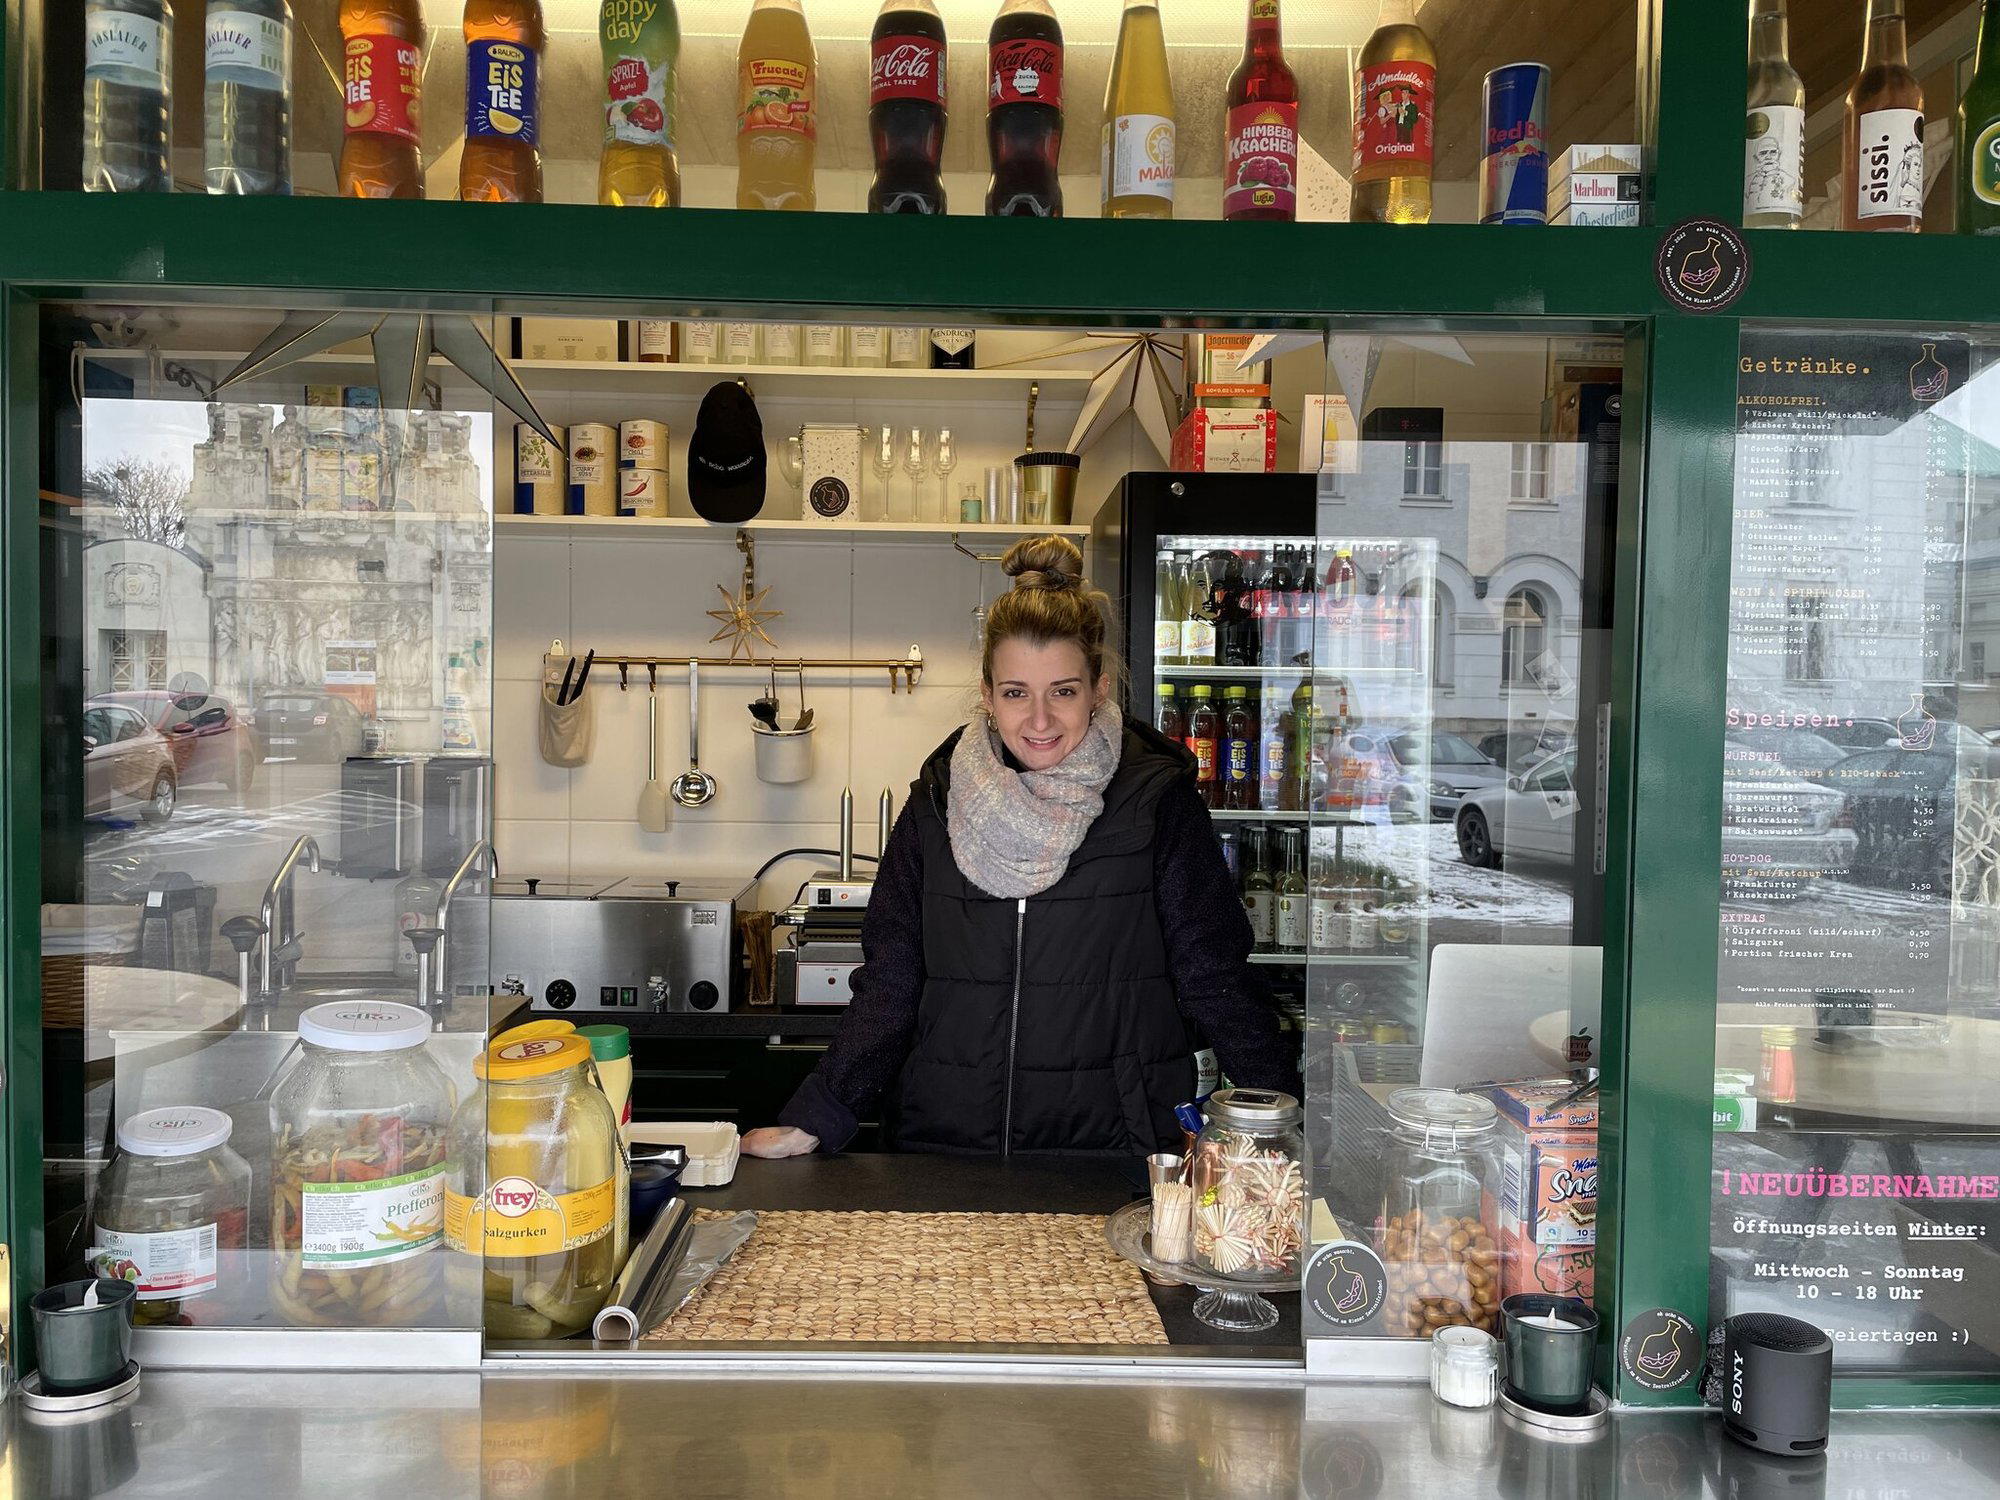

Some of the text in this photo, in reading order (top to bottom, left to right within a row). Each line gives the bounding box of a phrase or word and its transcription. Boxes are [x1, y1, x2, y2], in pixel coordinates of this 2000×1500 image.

[607, 18, 643, 44] day
[497, 48, 521, 59] RAUCH
[611, 63, 641, 84] SPRIZZ
[893, 79, 918, 87] TASTE
[1367, 70, 1424, 91] Almdudler
[619, 82, 637, 91] Apfel
[345, 80, 372, 105] TEE
[487, 84, 523, 111] TEE
[1242, 125, 1293, 141] HIMBEER
[1487, 120, 1522, 145] Red
[1375, 142, 1415, 154] Original
[1861, 134, 1890, 204] sissi.
[1574, 179, 1616, 198] Marlboro
[1575, 204, 1637, 226] Chesterfield
[1739, 356, 1871, 375] Getränke.
[1737, 396, 1827, 406] ALKOHOLFREI.
[1751, 409, 1792, 419] Vöslauer
[1751, 422, 1832, 430] Himbeer Kracherl
[1927, 425, 1947, 433] 2,50
[1751, 433, 1796, 441] Apfelsaft
[1750, 445, 1819, 453] Coca-Cola/Zero
[1750, 456, 1781, 464] Eistee
[1804, 468, 1840, 476] Frucade
[1925, 470, 1946, 478] 2,80
[1749, 478, 1779, 486] MAKAVA
[1734, 509, 1770, 519] BIER.
[1748, 533, 1803, 541] Ottakringer
[1792, 545, 1823, 553] Export
[1792, 555, 1822, 563] Export
[1781, 565, 1837, 574] Naturradler
[1730, 587, 1871, 598] WEIN & SPIRITUOSEN.
[1745, 602, 1785, 610] Spritzer
[1920, 604, 1941, 612] 2,90
[1744, 612, 1810, 620] Spritzer rosé
[1920, 614, 1941, 622] 2,90
[1743, 624, 1775, 632] Wiener
[1743, 636, 1808, 644] Wiener Dirndl
[1742, 648, 1804, 656] Jägermeister
[1919, 650, 1939, 658] 2,50
[1727, 707, 1854, 730] Speisen.
[1230, 758, 1246, 769] TEE
[1735, 781, 1800, 789] Frankfurter
[1735, 805, 1799, 813] Bratwürstel
[1913, 807, 1934, 815] 4,30
[1735, 816, 1799, 824] Käsekrainer
[1912, 818, 1934, 826] 4,50
[1912, 830, 1927, 838] 6,-
[1722, 853, 1772, 863] HOT-DOG
[1721, 868, 1741, 876] mit
[1733, 880, 1798, 888] Frankfurter
[1910, 883, 1931, 891] 3,50
[1733, 891, 1798, 899] Käsekrainer
[1910, 894, 1931, 902] 4,50
[1721, 913, 1766, 923] EXTRAS
[1732, 925, 1882, 937] Ölpfefferoni (mild/scharf)
[1909, 930, 1930, 938] 0,50
[1731, 939, 1784, 947] Salzgurke
[1909, 941, 1930, 949] 0,70
[1731, 950, 1773, 958] Portion
[1778, 950, 1825, 958] frischer
[1908, 952, 1929, 960] 0,70
[1568, 1112, 1596, 1126] Snack
[1713, 1111, 1733, 1123] bit
[494, 1187, 535, 1209] frey
[1733, 1216, 1987, 1238] Öffnungszeiten Winter:
[484, 1227, 547, 1239] Salzgurken
[1576, 1229, 1589, 1237] 10
[340, 1242, 365, 1252] 1900g
[1754, 1263, 1965, 1282] Mittwoch Sonntag
[1796, 1285, 1924, 1300] 10 18 Uhr
[1731, 1350, 1745, 1415] SONY
